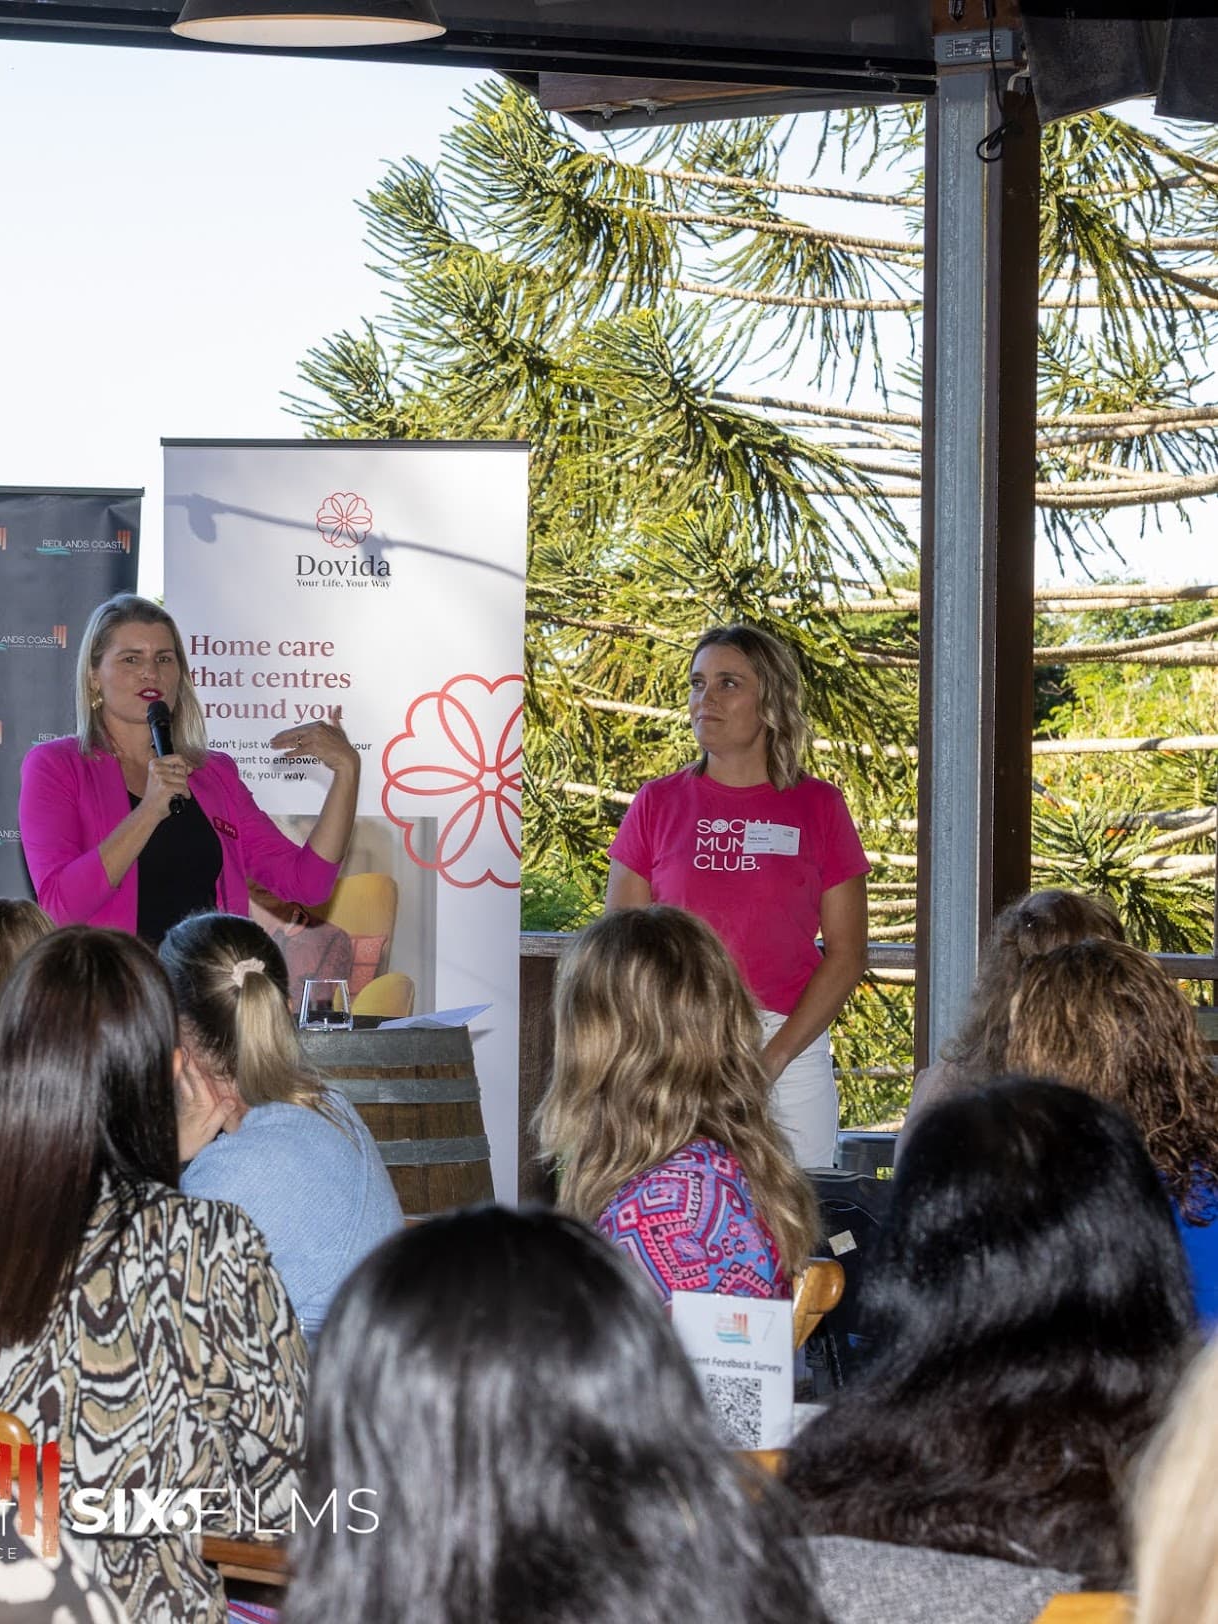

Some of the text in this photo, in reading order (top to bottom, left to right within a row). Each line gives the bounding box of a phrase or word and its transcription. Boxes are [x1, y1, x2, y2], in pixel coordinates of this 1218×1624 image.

[42, 539, 123, 550] REDLANDS COAST
[295, 554, 392, 577] Dovida
[296, 579, 319, 588] Your
[346, 579, 368, 588] Your
[371, 579, 391, 589] Way
[27, 635, 58, 645] COAST
[190, 635, 335, 657] Home care
[190, 666, 351, 689] that centres
[209, 738, 236, 749] don't
[238, 739, 259, 751] just
[259, 756, 271, 765] to
[258, 771, 282, 782] your
[284, 772, 308, 783] way.
[693, 853, 761, 872] CLUB.
[712, 1356, 751, 1370] Feedback
[753, 1360, 782, 1375] Survey
